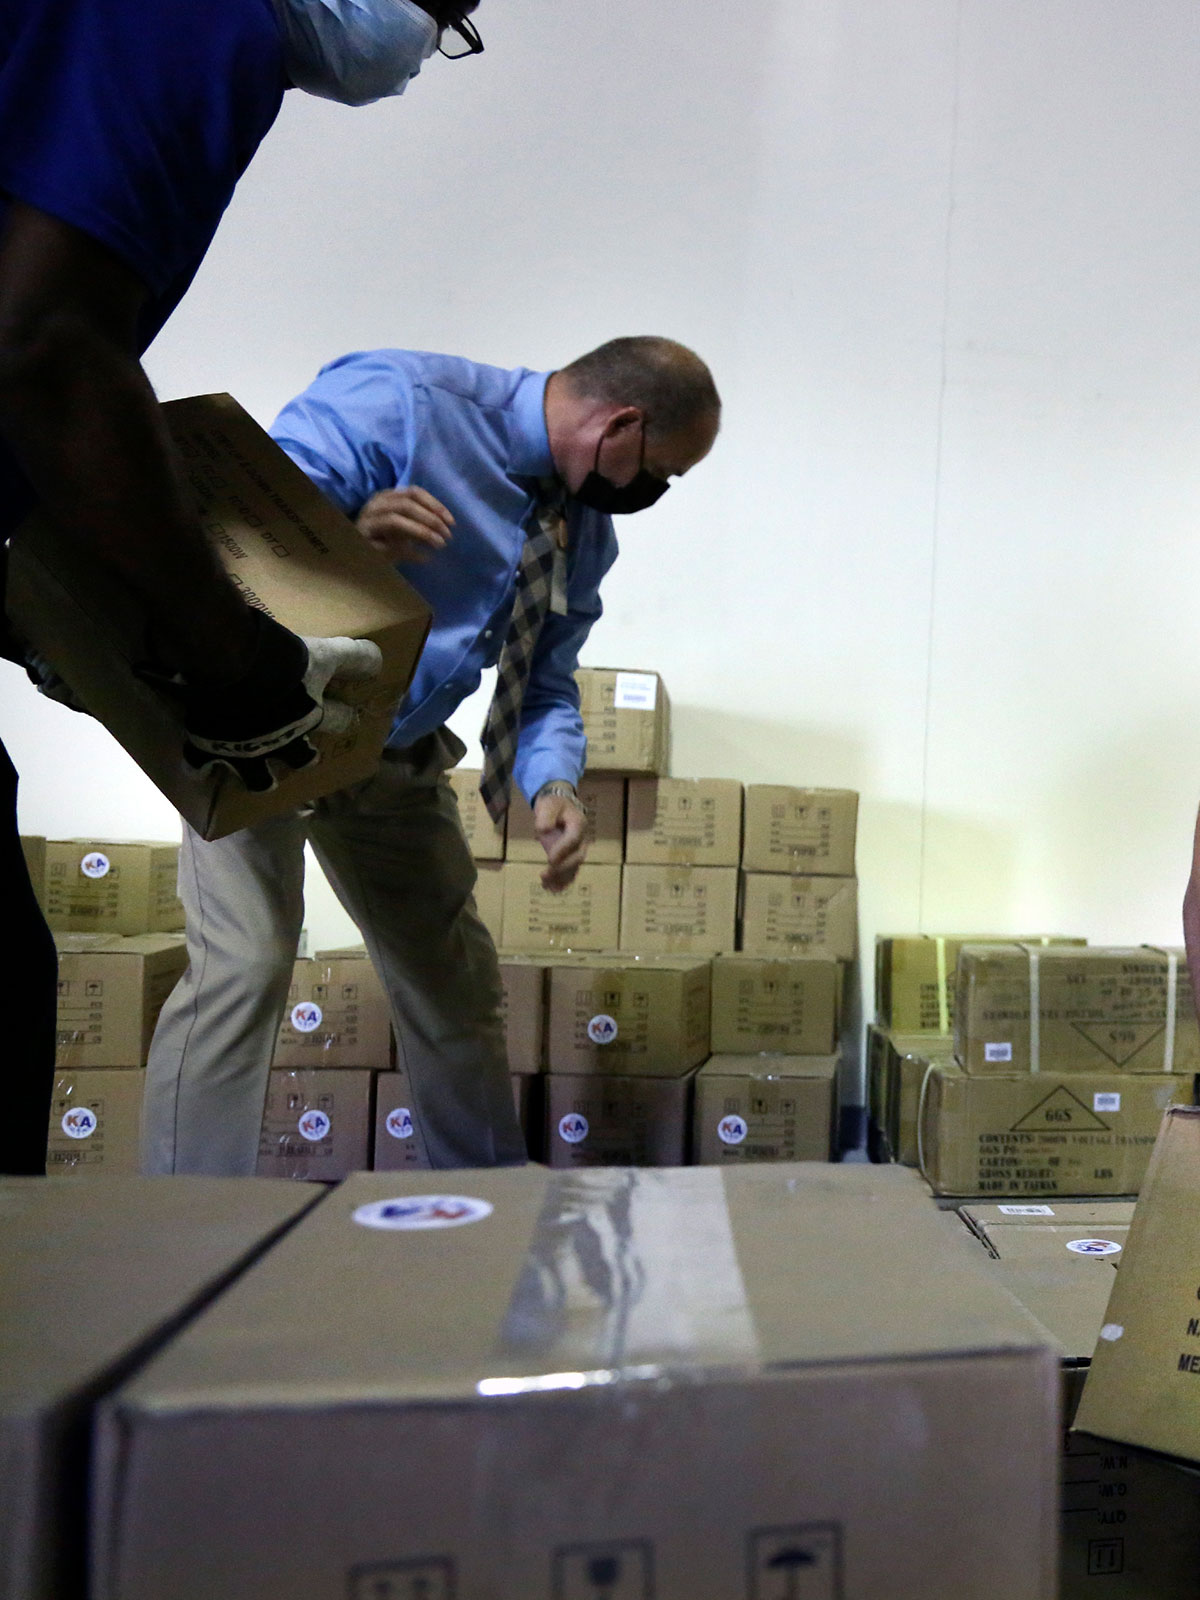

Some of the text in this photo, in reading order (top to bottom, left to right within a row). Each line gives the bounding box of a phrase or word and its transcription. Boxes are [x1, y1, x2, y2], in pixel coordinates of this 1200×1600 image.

[296, 1009, 317, 1022] KA
[592, 1022, 614, 1034] KA
[67, 1115, 91, 1128] KA
[302, 1117, 326, 1132] KA
[390, 1116, 412, 1128] KA
[563, 1121, 585, 1133] KA
[722, 1122, 742, 1135] KA
